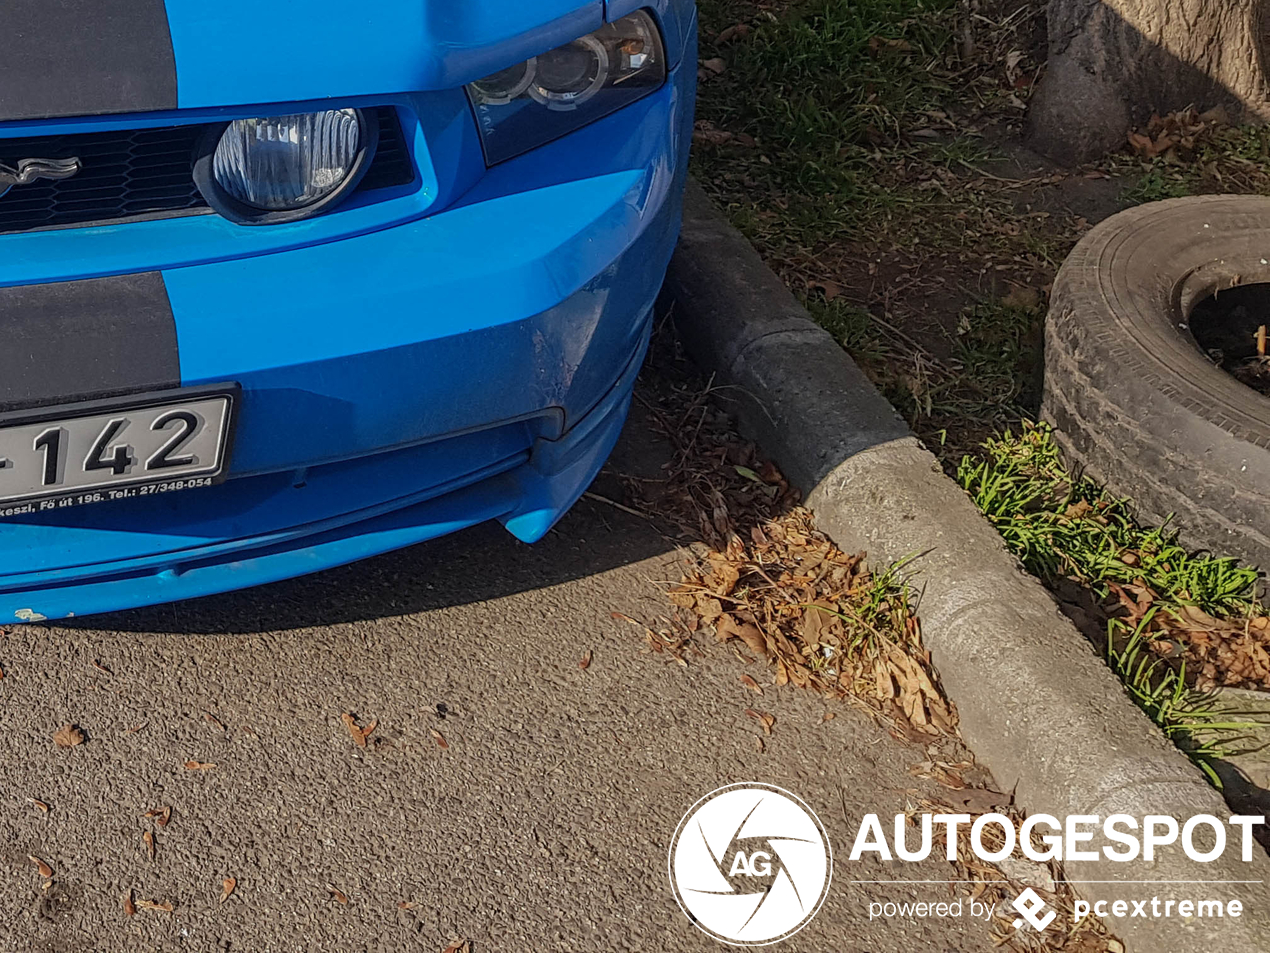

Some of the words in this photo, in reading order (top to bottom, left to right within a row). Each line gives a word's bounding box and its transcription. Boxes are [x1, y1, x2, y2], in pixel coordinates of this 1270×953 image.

[59, 497, 73, 508] út
[77, 493, 105, 504] 196.
[108, 489, 136, 500] Tel.:
[139, 477, 213, 495] 27/348-054
